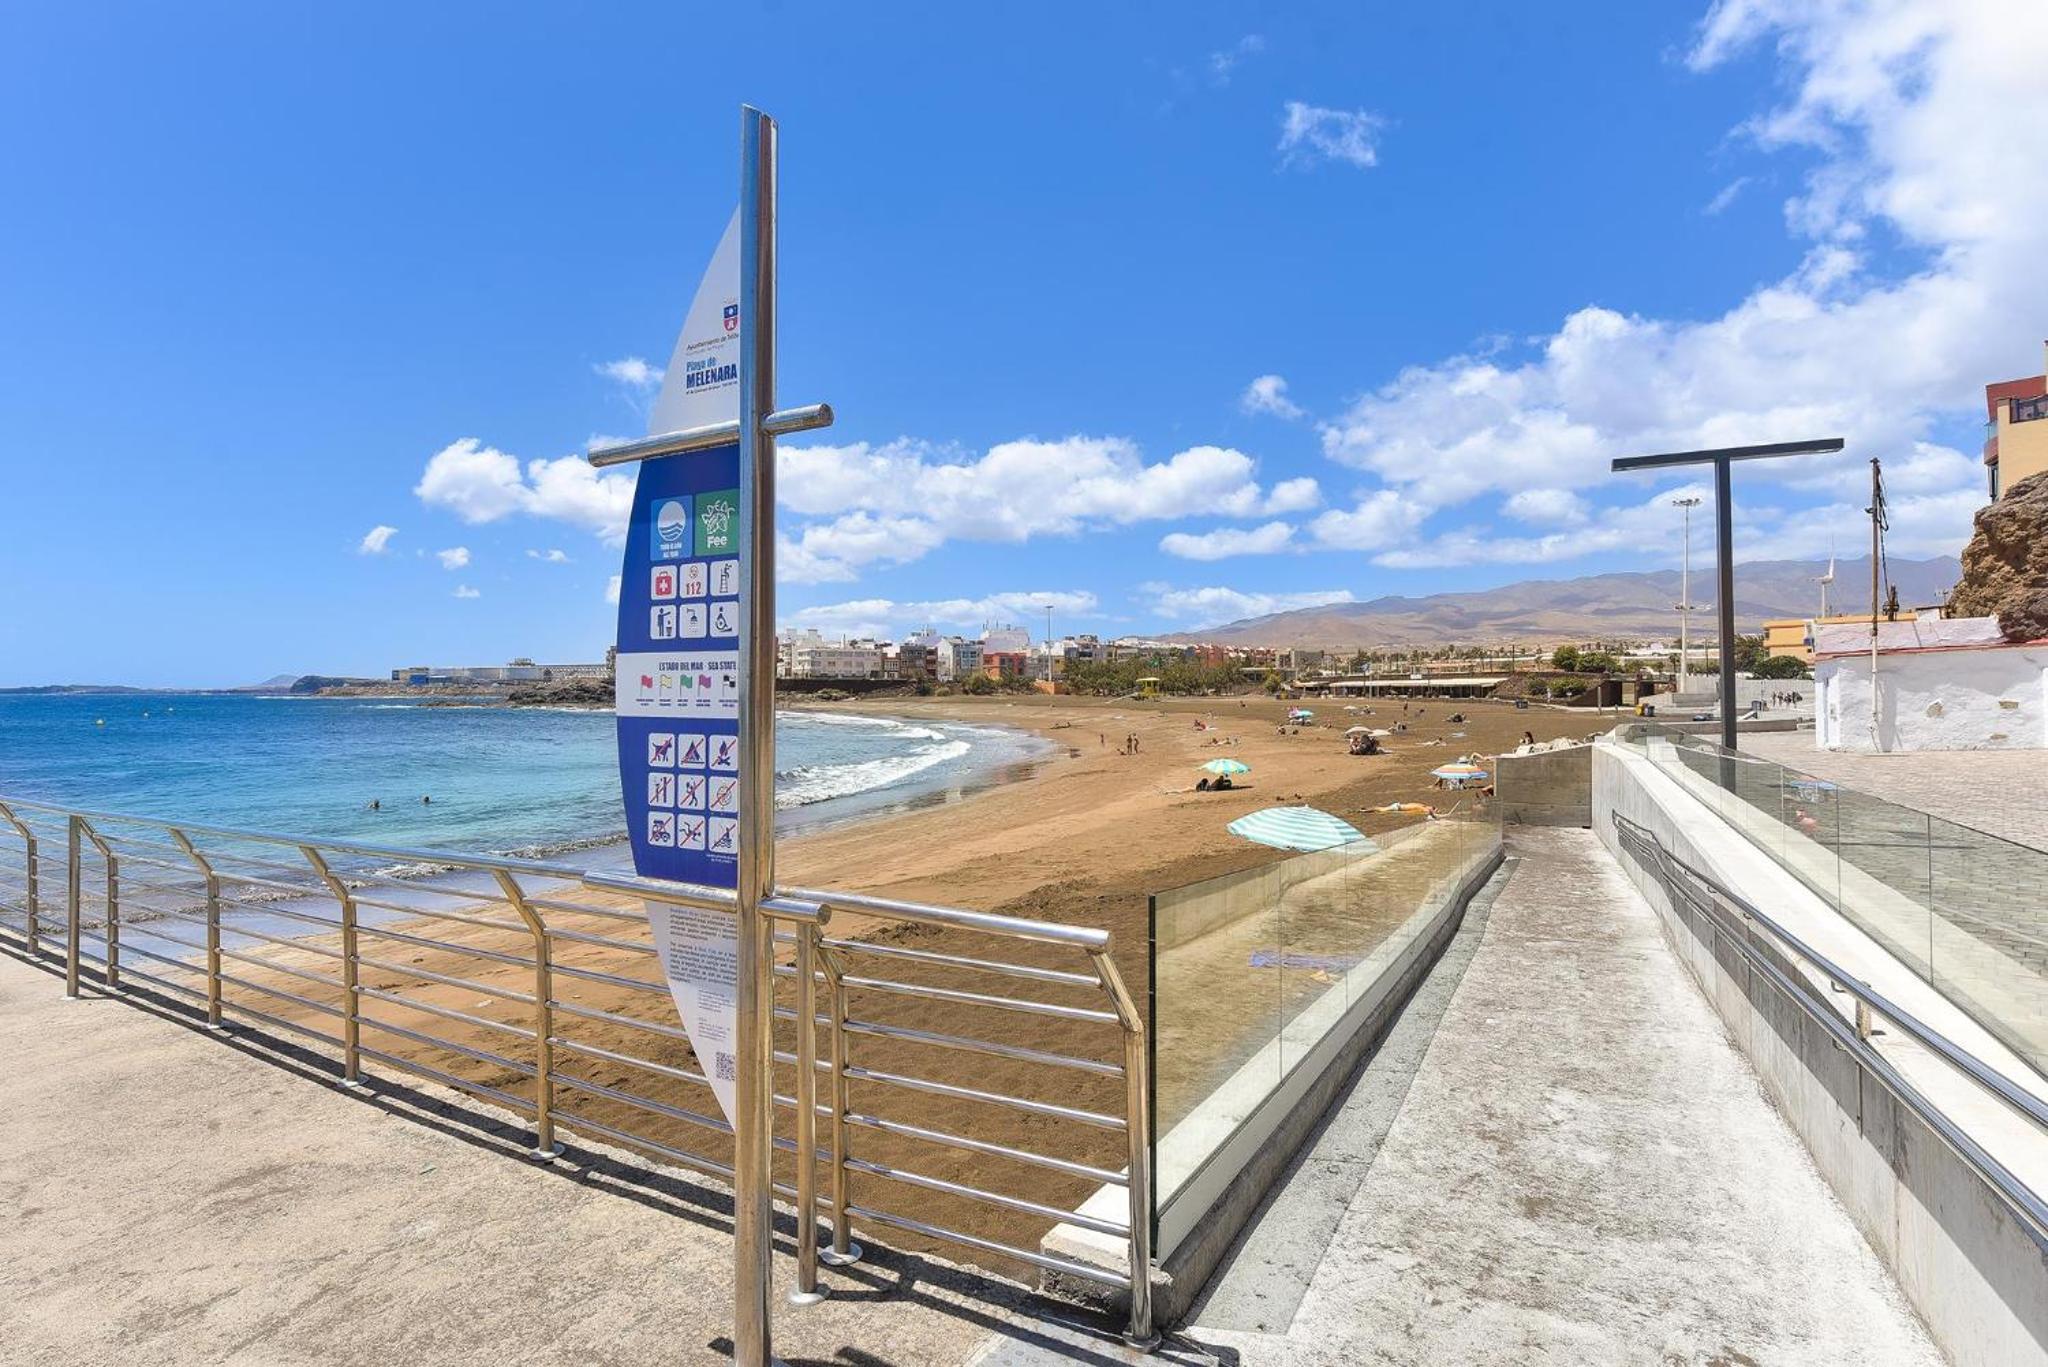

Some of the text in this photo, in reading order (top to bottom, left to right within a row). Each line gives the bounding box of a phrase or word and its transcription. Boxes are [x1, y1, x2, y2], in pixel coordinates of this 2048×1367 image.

[686, 363, 738, 389] MELENARA
[686, 582, 701, 595] 112
[659, 661, 736, 671] ESTADO DEL MAR SEA STATE
